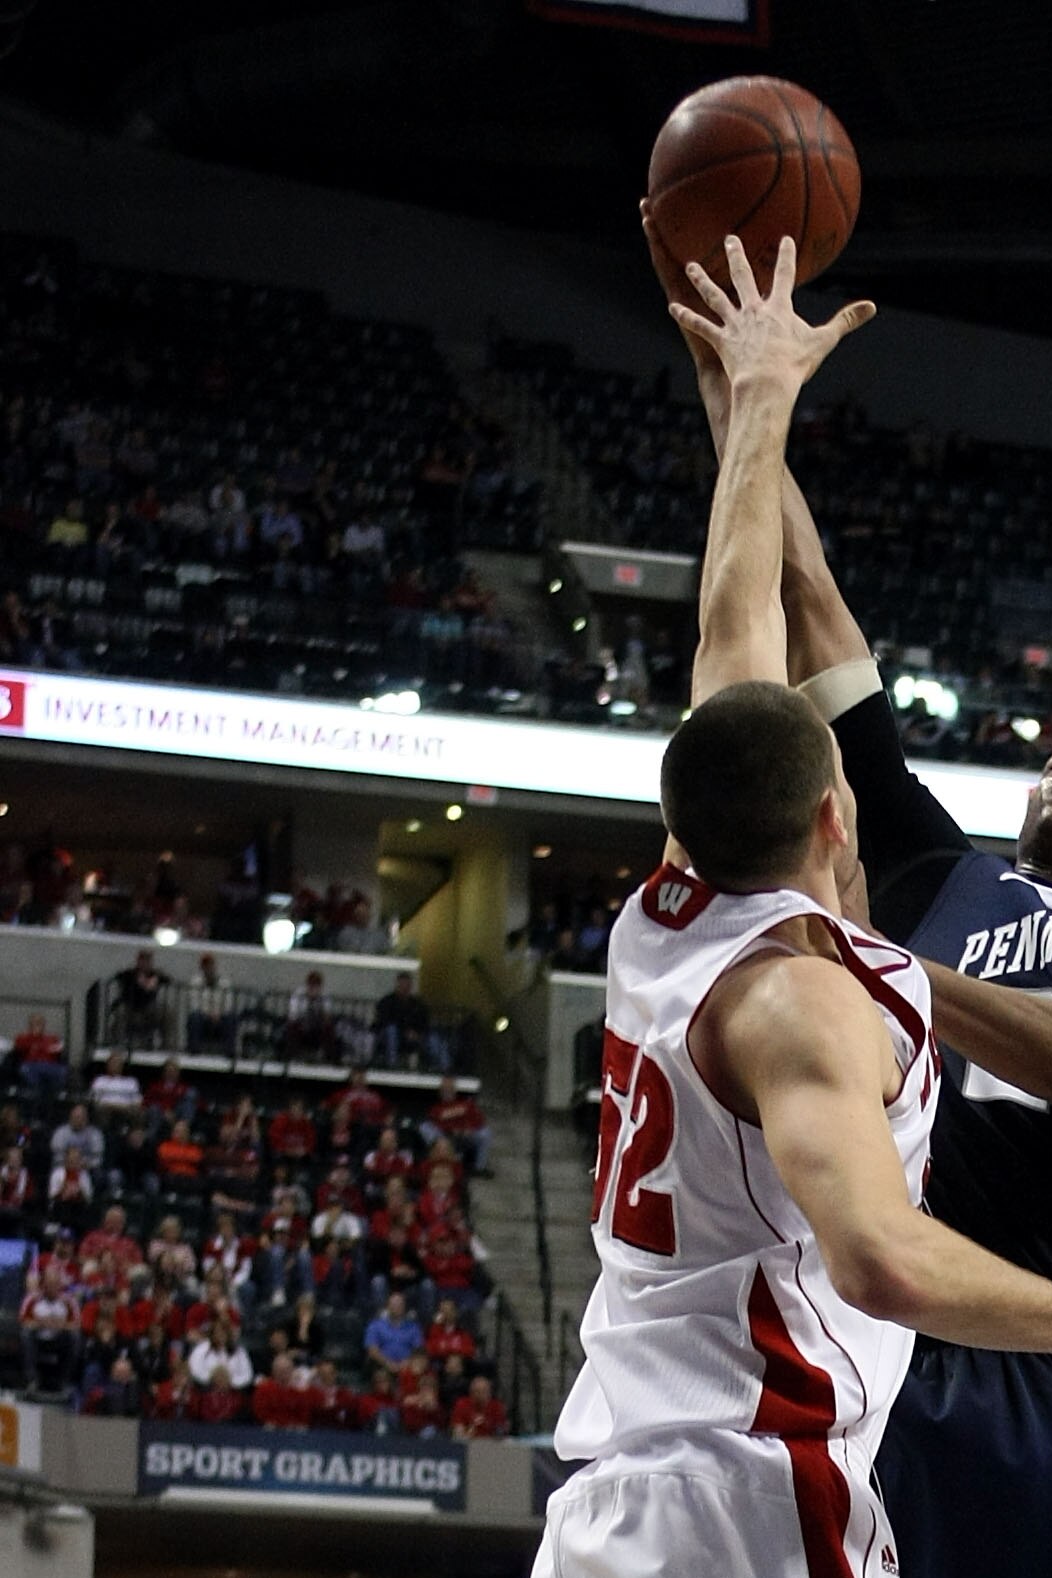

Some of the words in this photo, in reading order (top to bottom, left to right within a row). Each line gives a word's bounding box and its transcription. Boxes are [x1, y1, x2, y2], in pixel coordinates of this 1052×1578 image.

[45, 696, 227, 735] INVESTMENT
[241, 718, 446, 758] MANAGEMENT
[146, 1442, 270, 1480] SPORT
[273, 1450, 460, 1492] GRAPHICS
